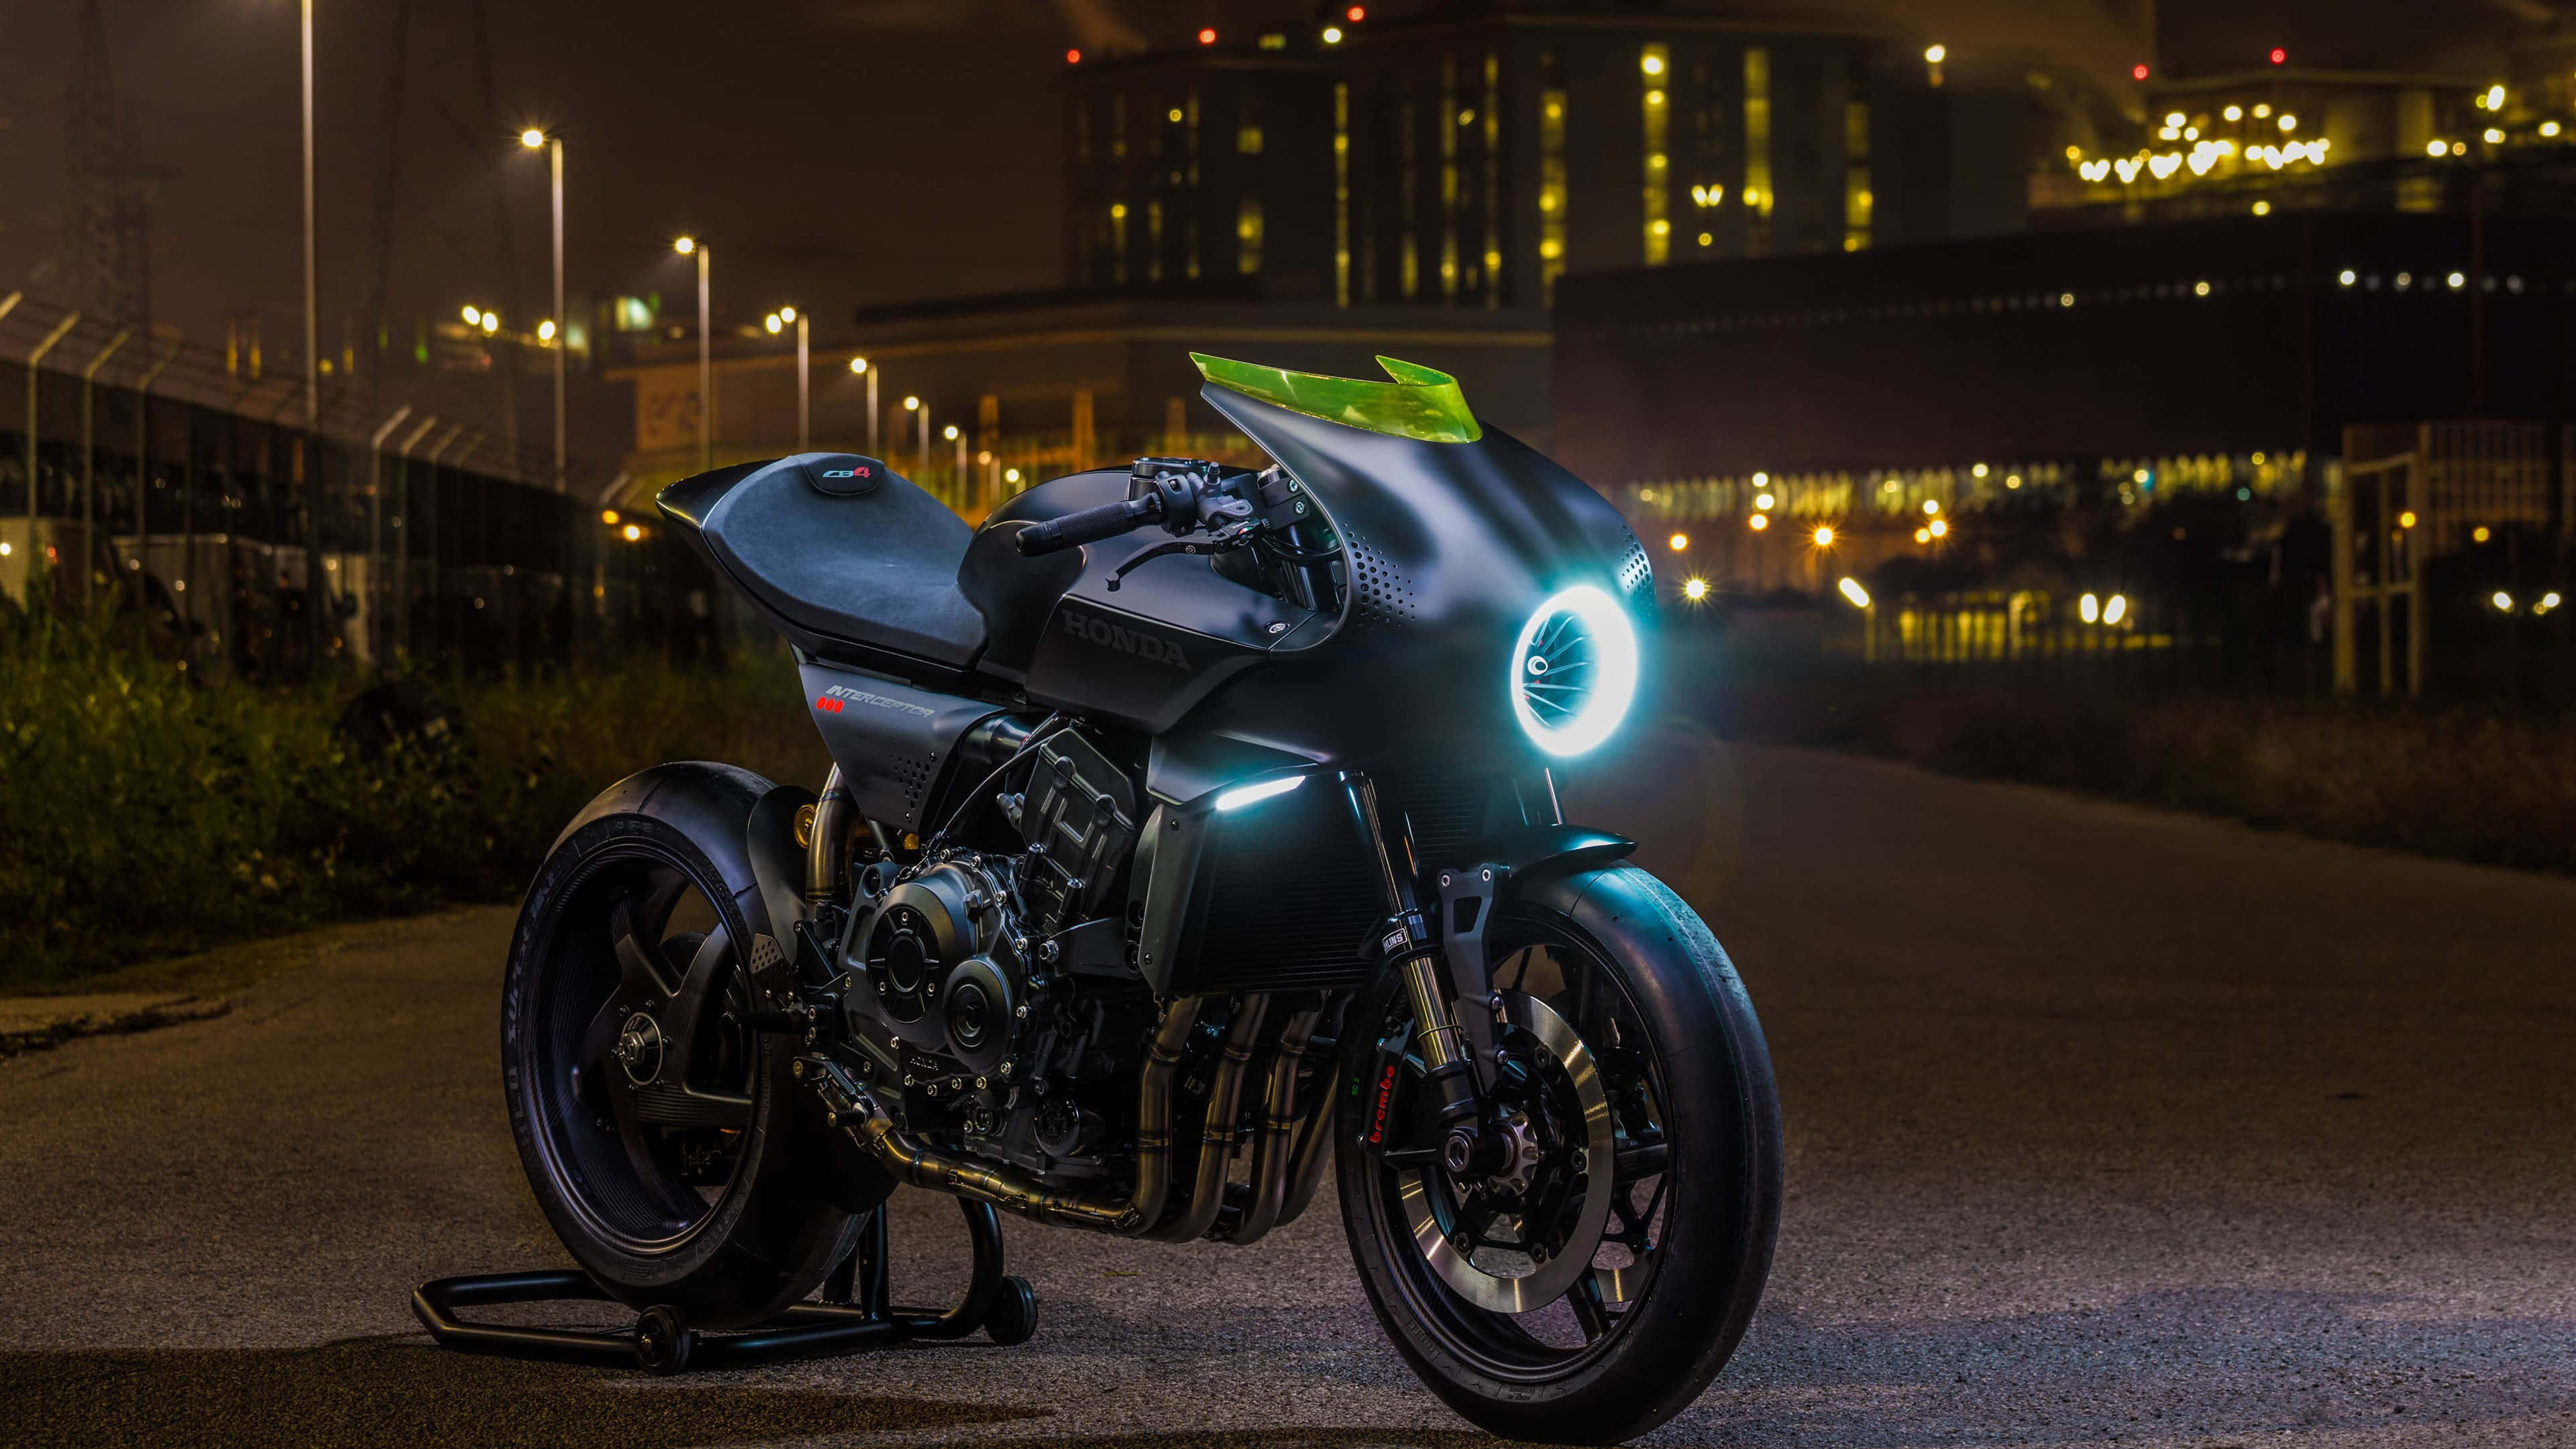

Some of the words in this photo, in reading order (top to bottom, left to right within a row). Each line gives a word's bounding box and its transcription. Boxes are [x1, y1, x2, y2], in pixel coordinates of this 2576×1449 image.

[1062, 608, 1191, 670] HONDA
[825, 685, 935, 718] INTERCEPTOR
[1368, 1065, 1395, 1143] brembo
